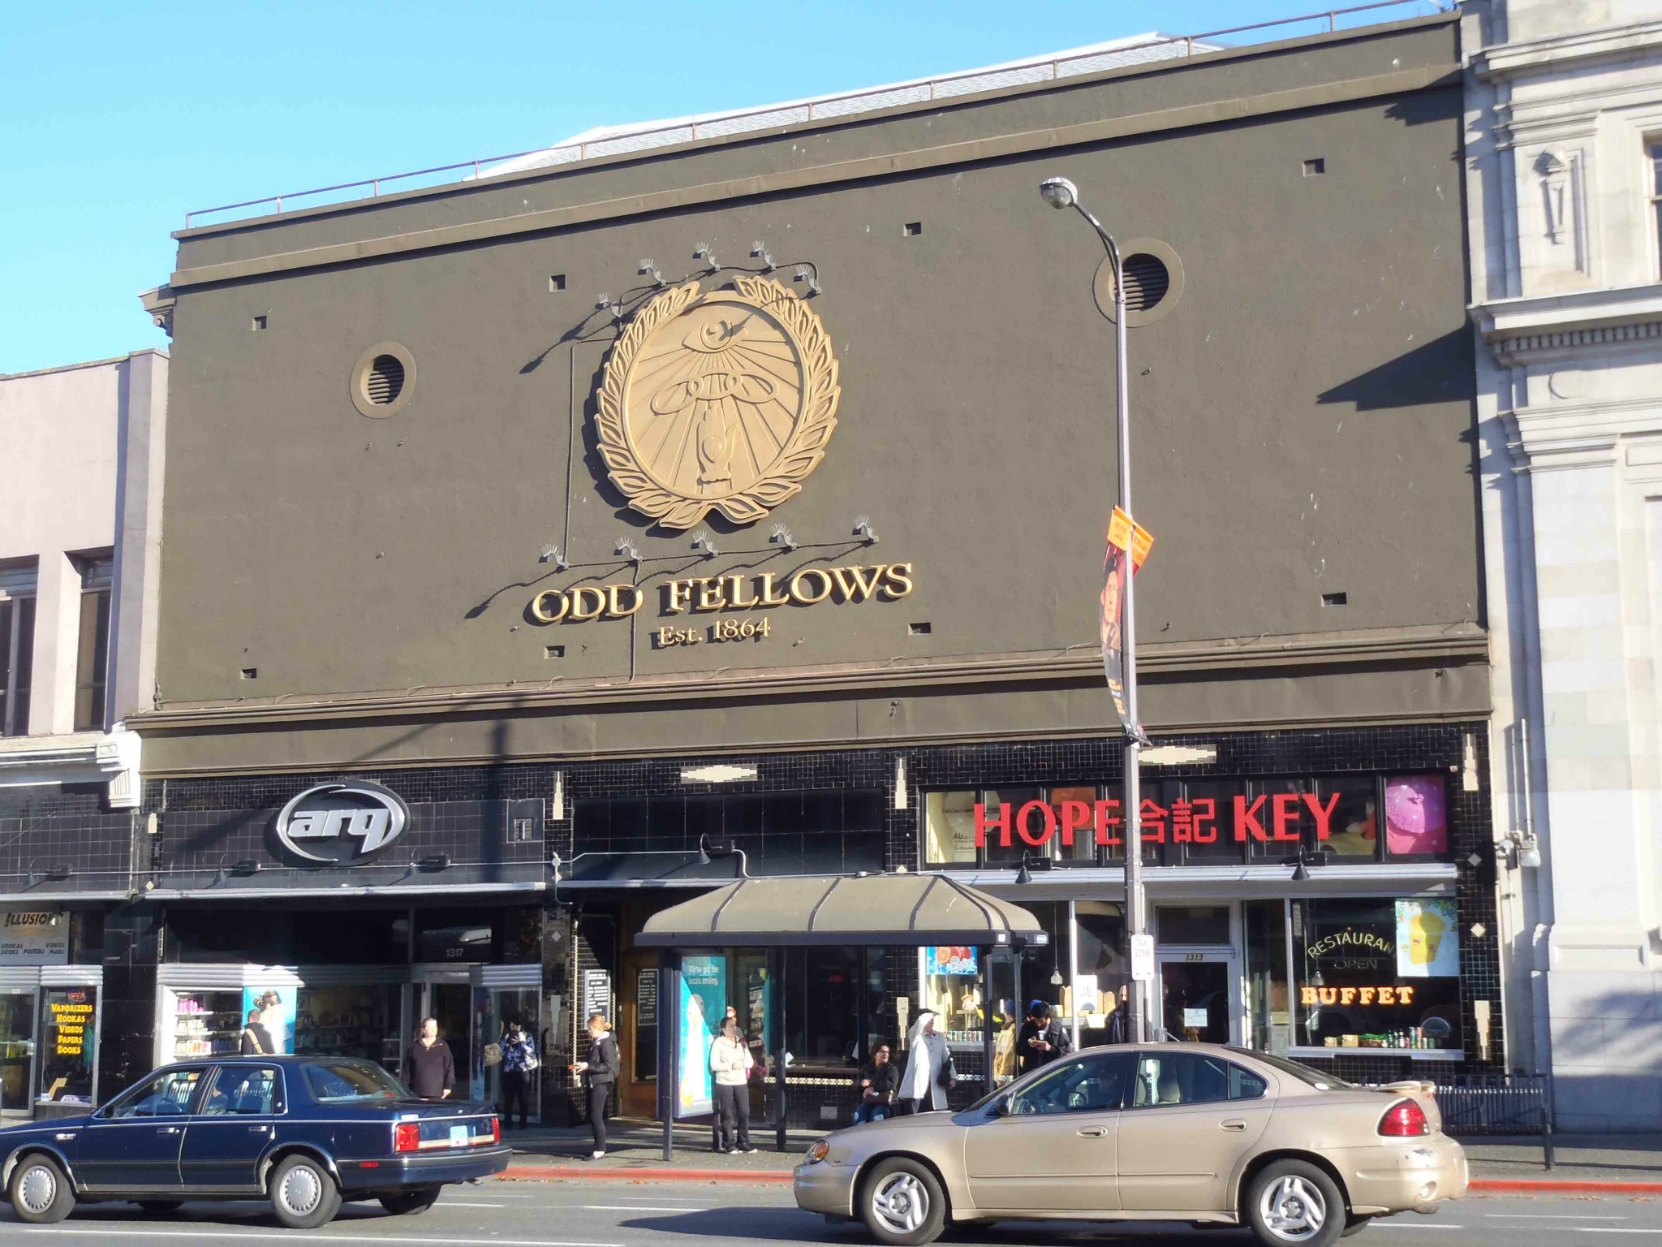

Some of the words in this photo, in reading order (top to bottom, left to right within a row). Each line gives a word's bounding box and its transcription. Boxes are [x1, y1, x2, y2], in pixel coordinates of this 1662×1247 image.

[531, 583, 644, 622] ODD
[665, 562, 914, 613] FELLOWS
[658, 624, 704, 646] Est.
[714, 616, 772, 640] 1864
[973, 798, 1120, 848] HOPE
[1138, 796, 1218, 844] 合記
[1233, 792, 1341, 843] KEY
[287, 808, 390, 854] arq
[445, 948, 465, 958] 1317
[1307, 932, 1397, 959] RESTAURAN
[1333, 958, 1378, 970] OPEN
[1301, 986, 1414, 1005] BUFFET
[56, 1014, 86, 1023] HOOKAS
[59, 1024, 84, 1034] VIDEOS
[57, 1034, 83, 1044] PAPERS
[57, 1045, 81, 1055] BOOKS
